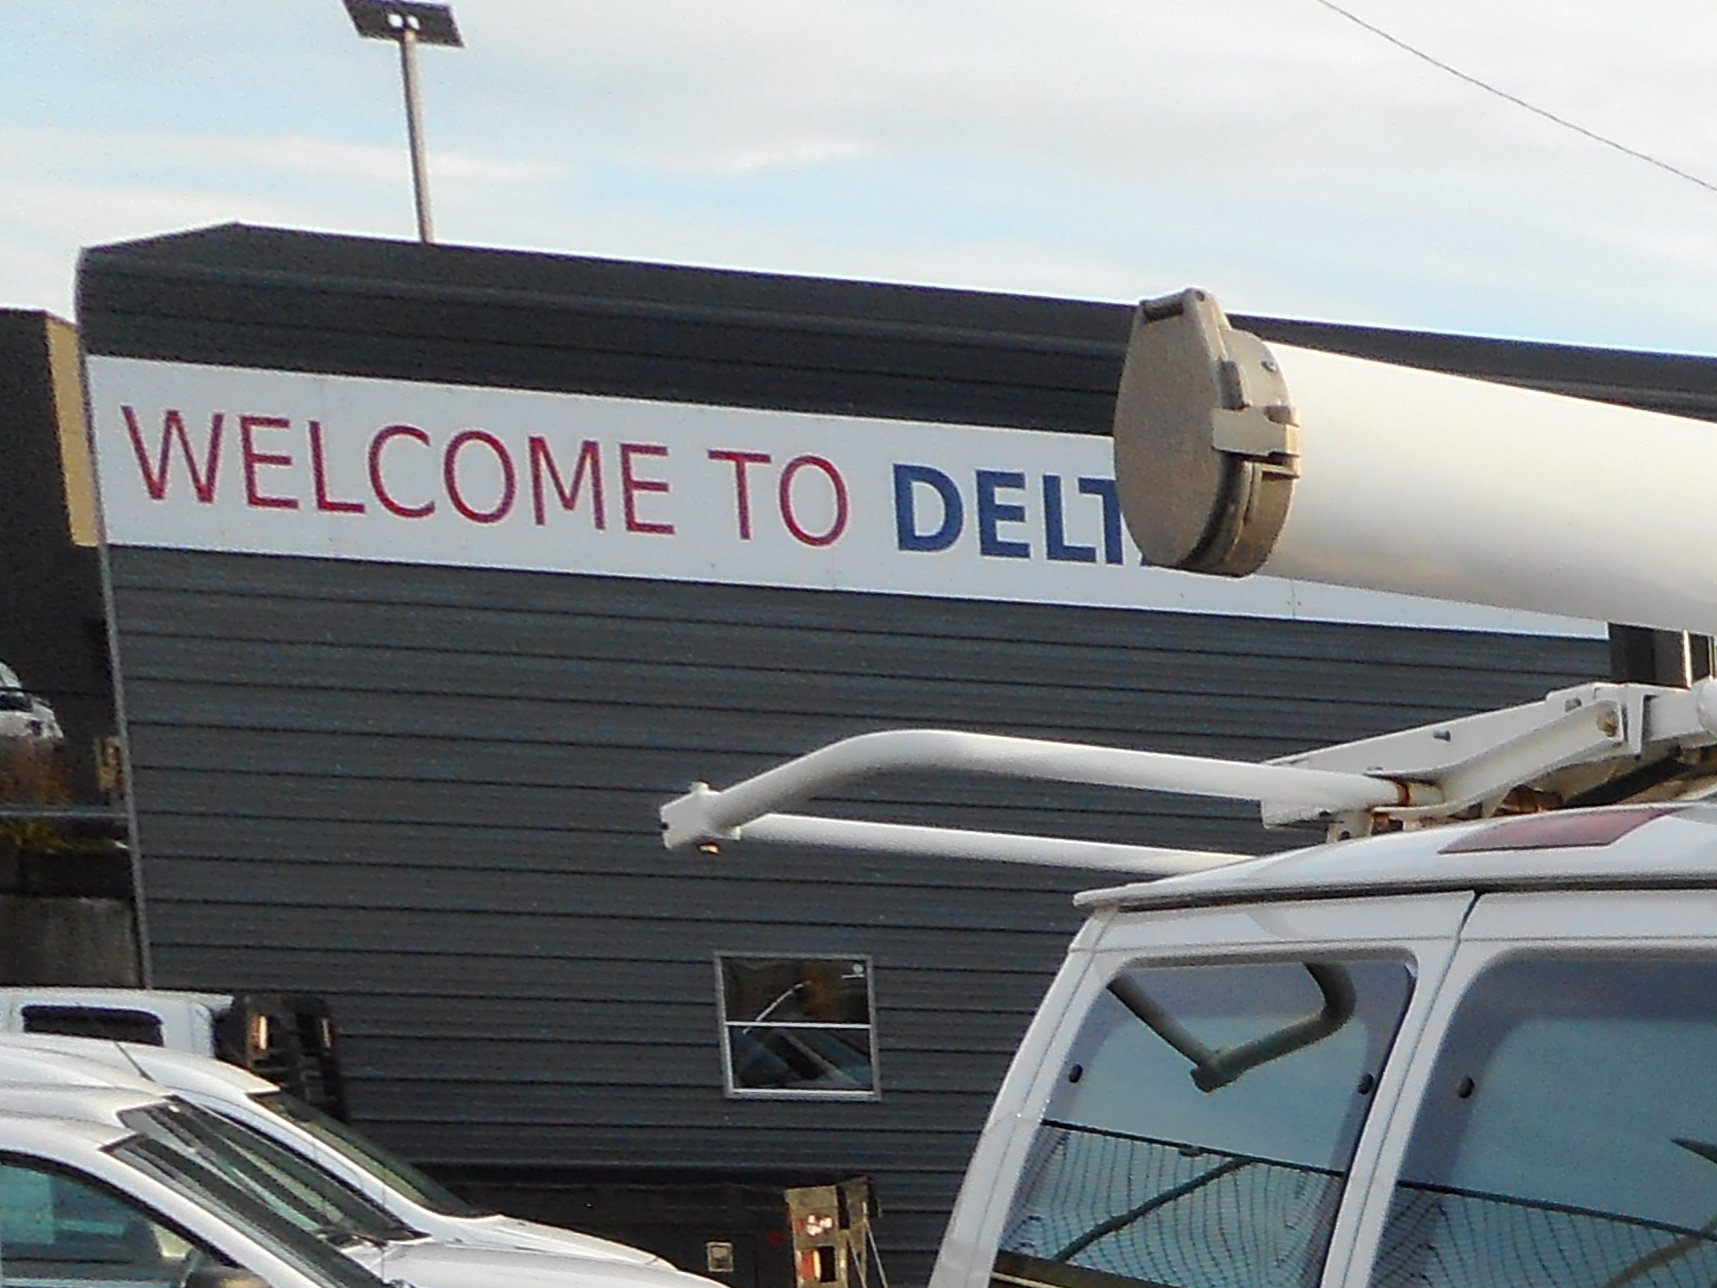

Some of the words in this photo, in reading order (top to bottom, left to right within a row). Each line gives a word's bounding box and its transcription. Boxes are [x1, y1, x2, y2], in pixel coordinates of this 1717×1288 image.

[122, 404, 676, 537] WELCOME
[708, 447, 850, 548] TO
[891, 463, 1145, 568] DELT
